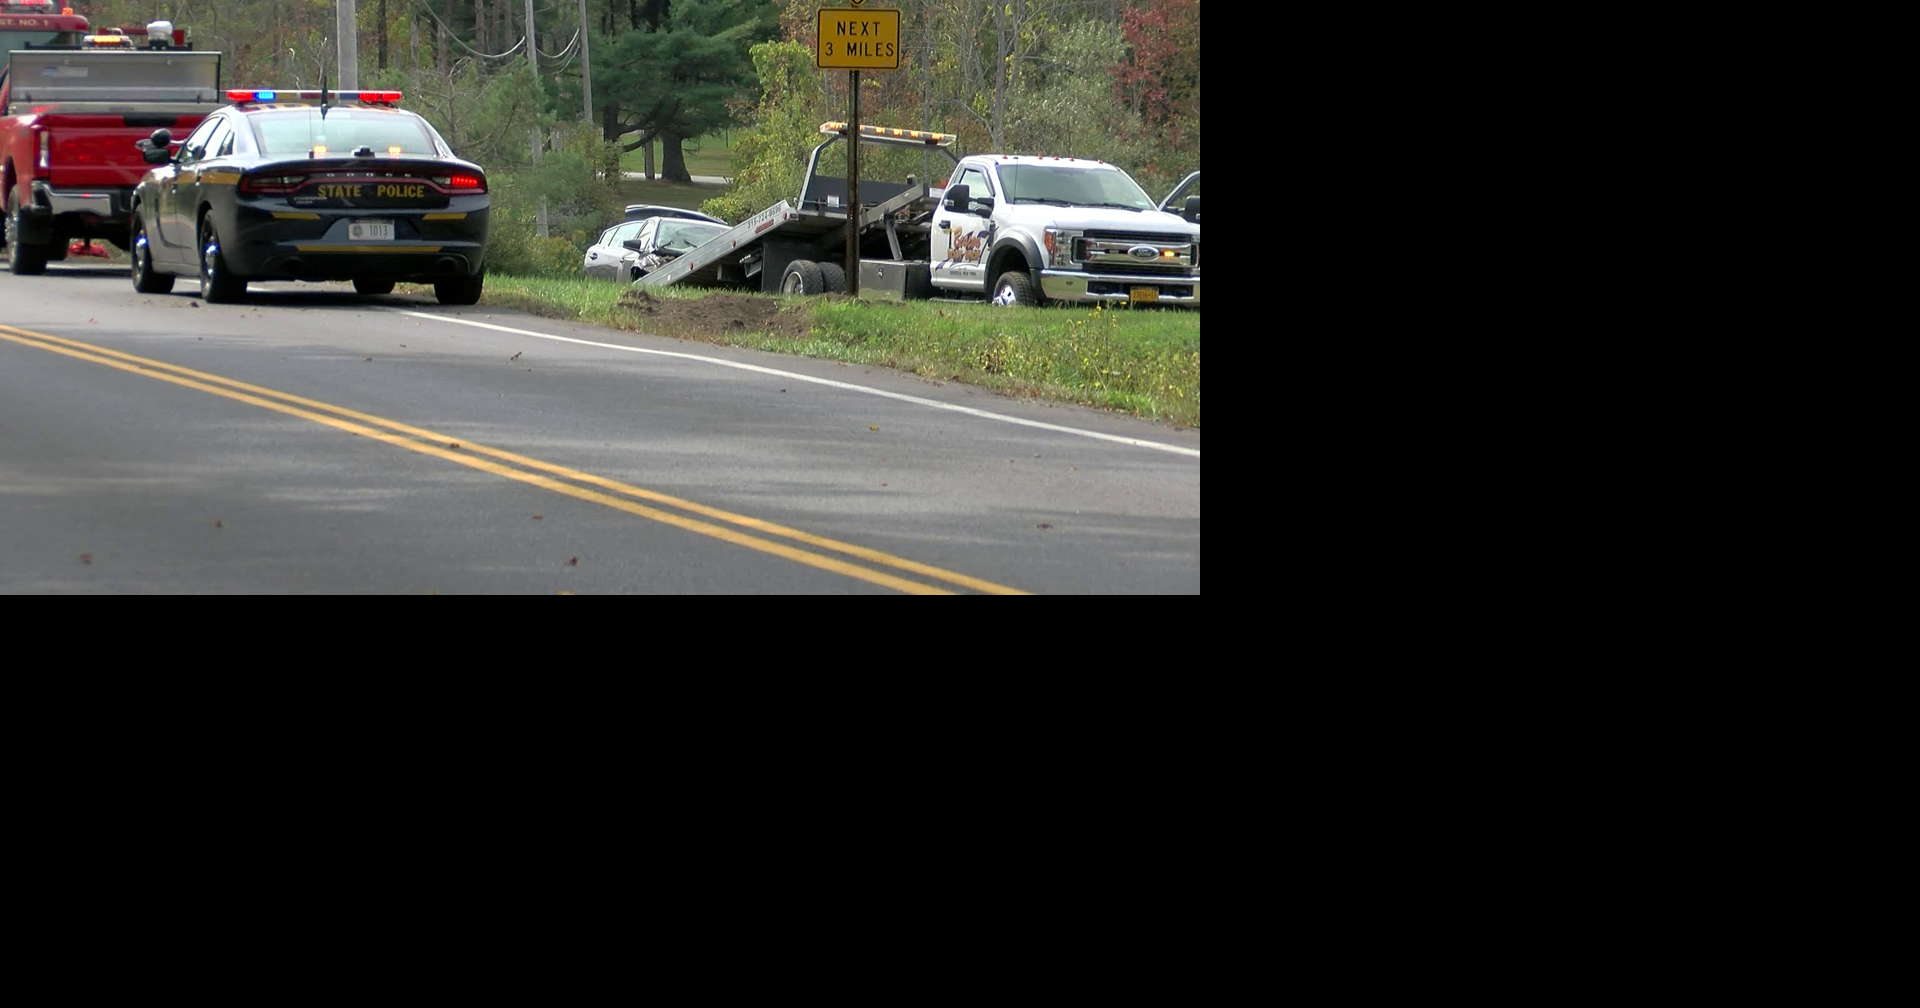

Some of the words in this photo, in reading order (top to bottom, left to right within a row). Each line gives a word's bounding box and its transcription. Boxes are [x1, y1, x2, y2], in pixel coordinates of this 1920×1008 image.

[836, 21, 880, 36] NEXT
[825, 42, 833, 56] 3
[846, 42, 894, 57] MILES
[317, 184, 362, 198] STATE
[377, 184, 425, 198] POLICE
[369, 225, 388, 236] 1013
